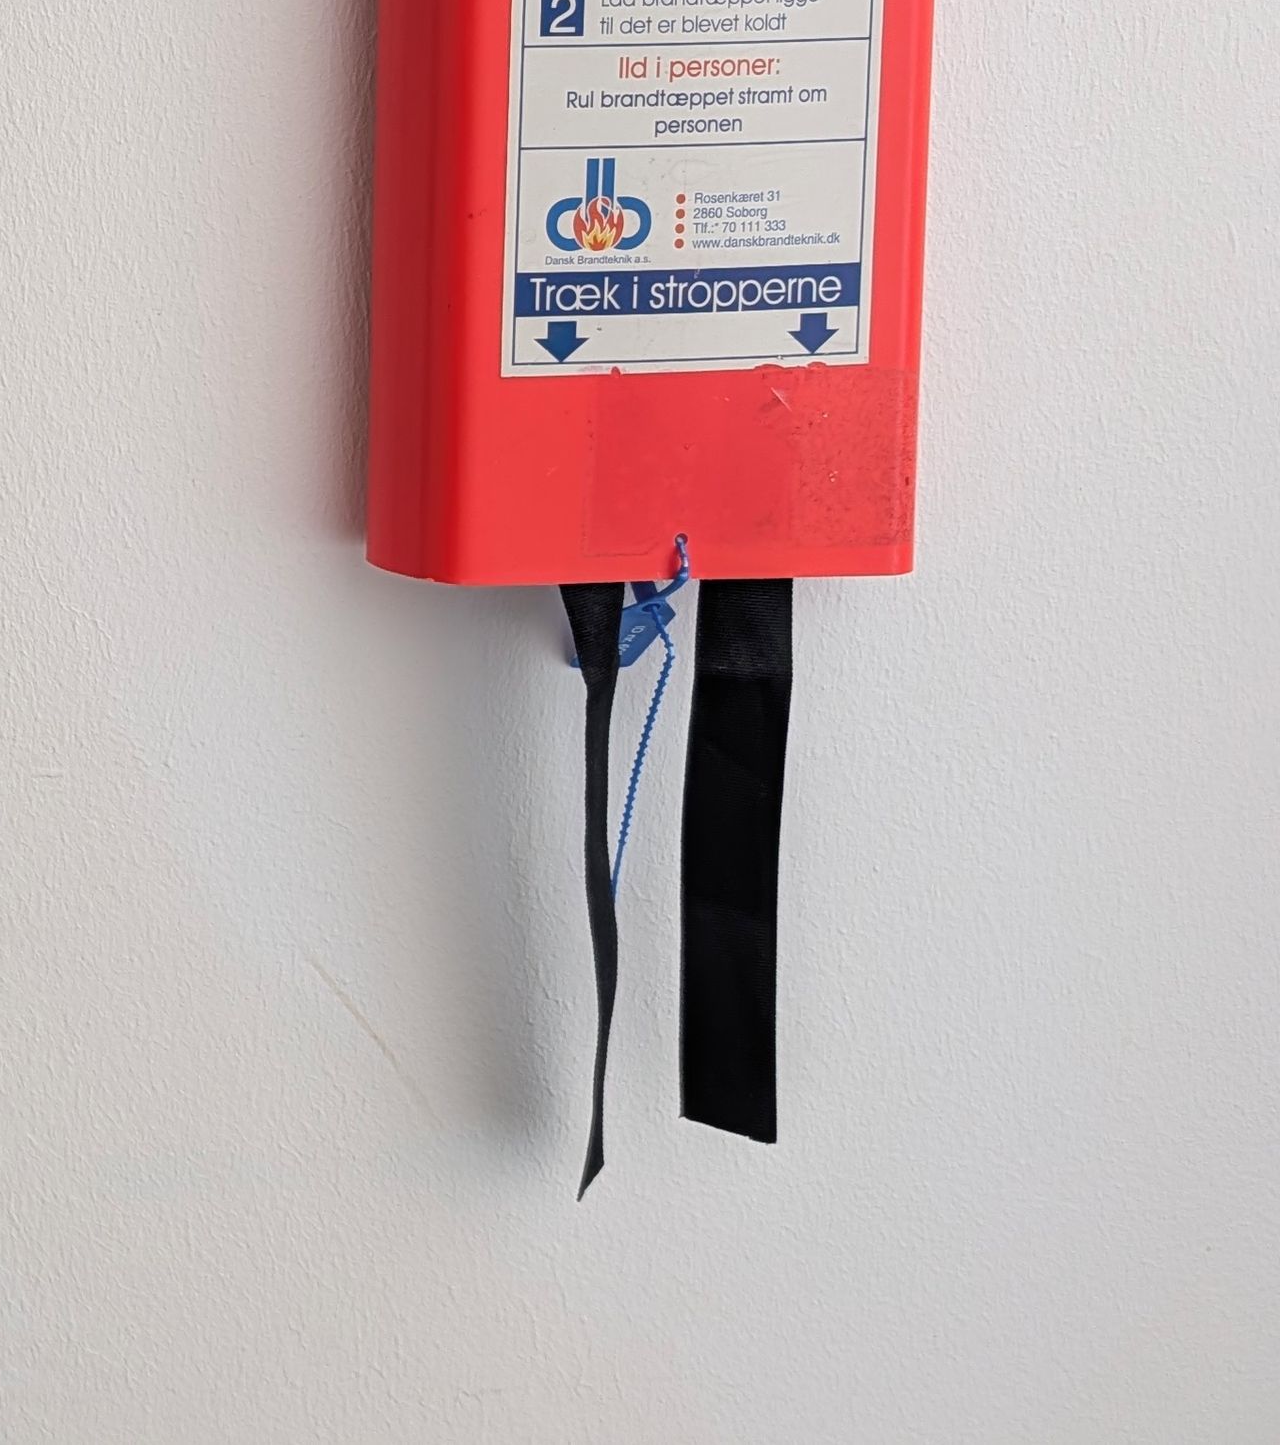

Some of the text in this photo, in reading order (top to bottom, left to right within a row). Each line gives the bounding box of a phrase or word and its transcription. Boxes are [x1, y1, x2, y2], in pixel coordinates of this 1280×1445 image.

[600, 13, 787, 35] til det er blevet koldt
[655, 57, 661, 78] i
[669, 56, 781, 83] personer:
[566, 87, 827, 110] Rul brandtæppet stramt om
[654, 116, 743, 138] personen
[694, 190, 781, 204] Rosenkæret 31
[693, 207, 723, 219] 2860
[721, 221, 737, 233] 70
[740, 221, 760, 232] 111
[764, 220, 786, 231] 333
[692, 232, 841, 249] www.danskbrandteknik.dk
[545, 255, 652, 266] Dansk Brandteknik a.s.
[529, 274, 842, 313] Træk i stropperne
